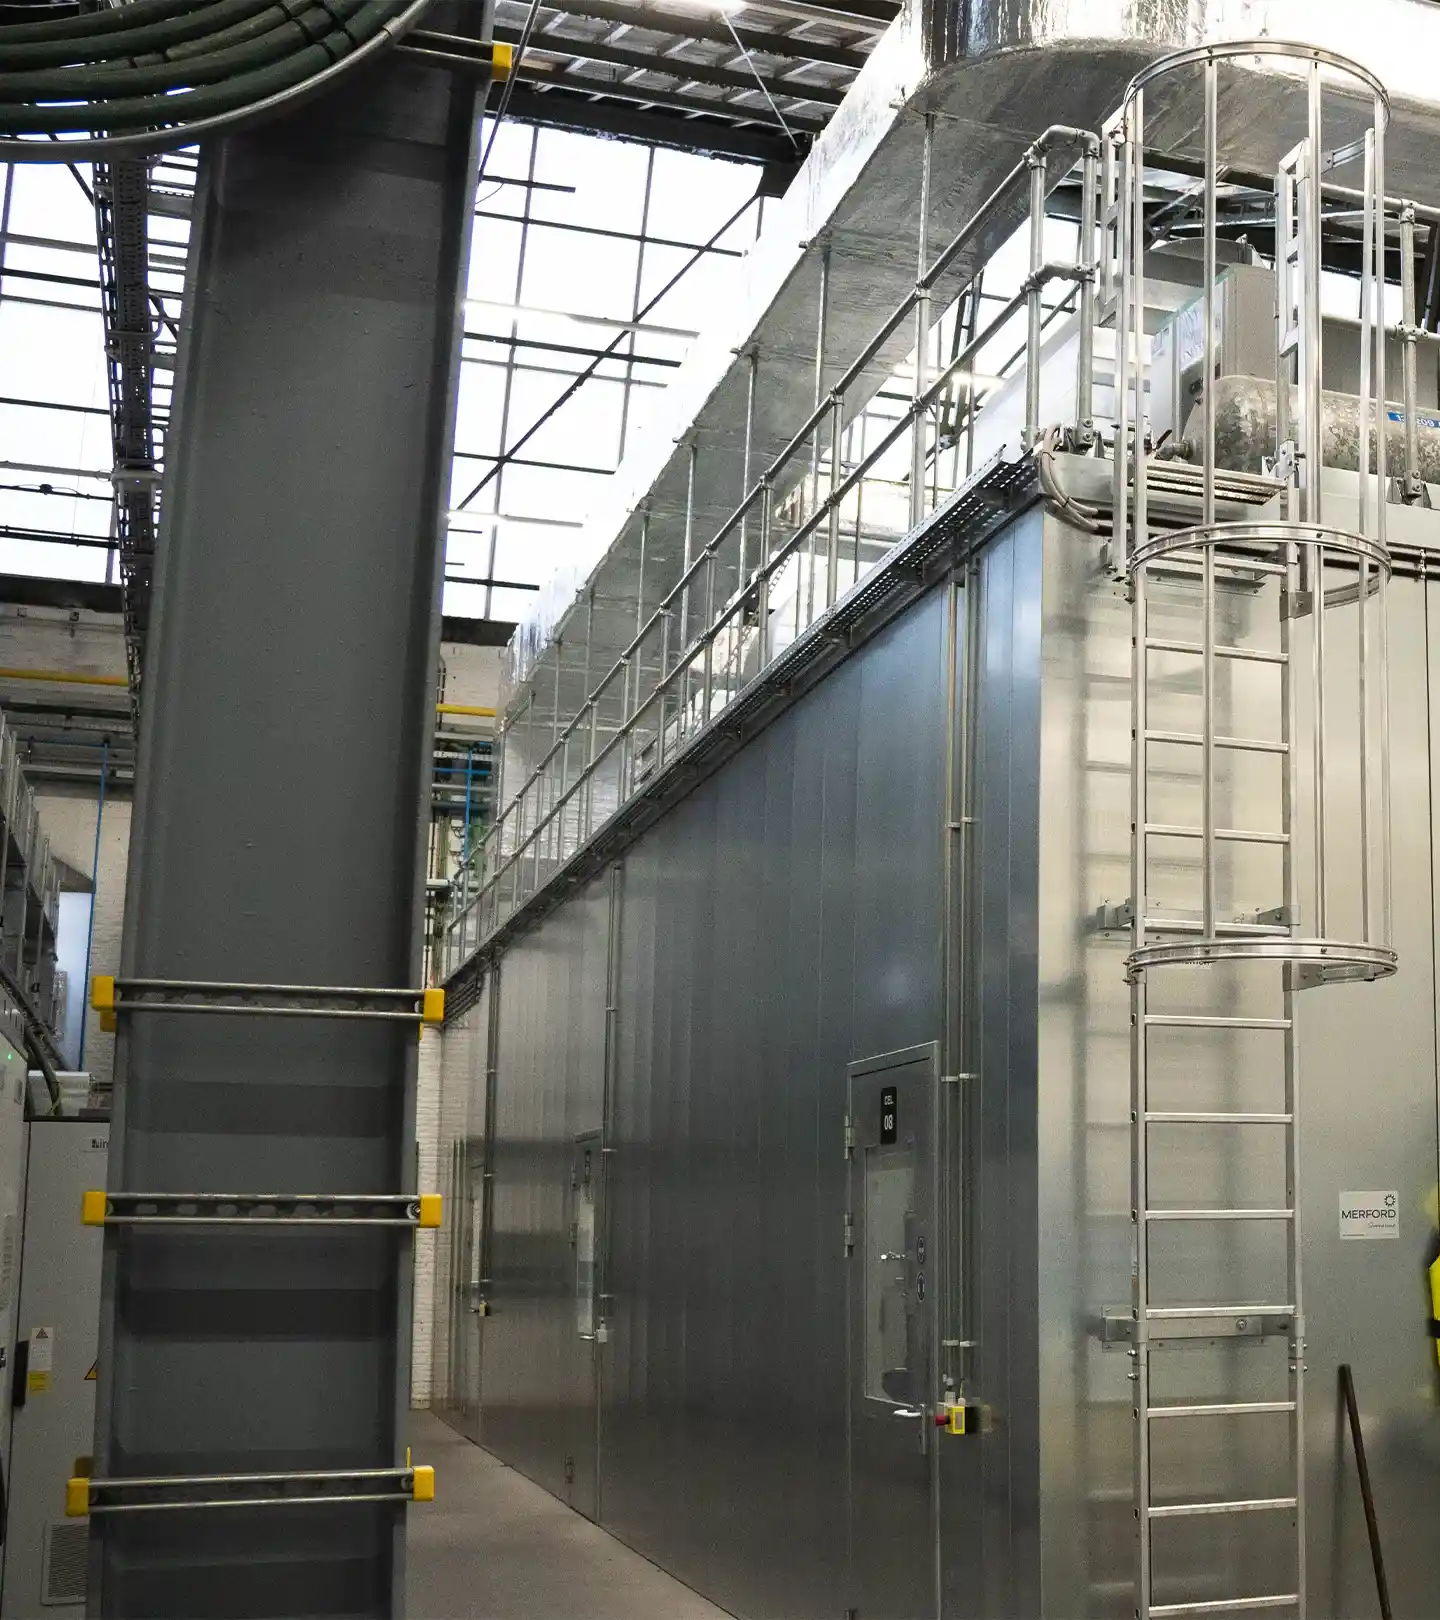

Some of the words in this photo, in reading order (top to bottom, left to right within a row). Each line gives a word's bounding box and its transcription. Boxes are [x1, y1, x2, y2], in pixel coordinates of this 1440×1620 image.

[884, 1094, 894, 1106] CEL
[884, 1114, 894, 1131] 08
[1341, 1209, 1397, 1219] MERFORD
